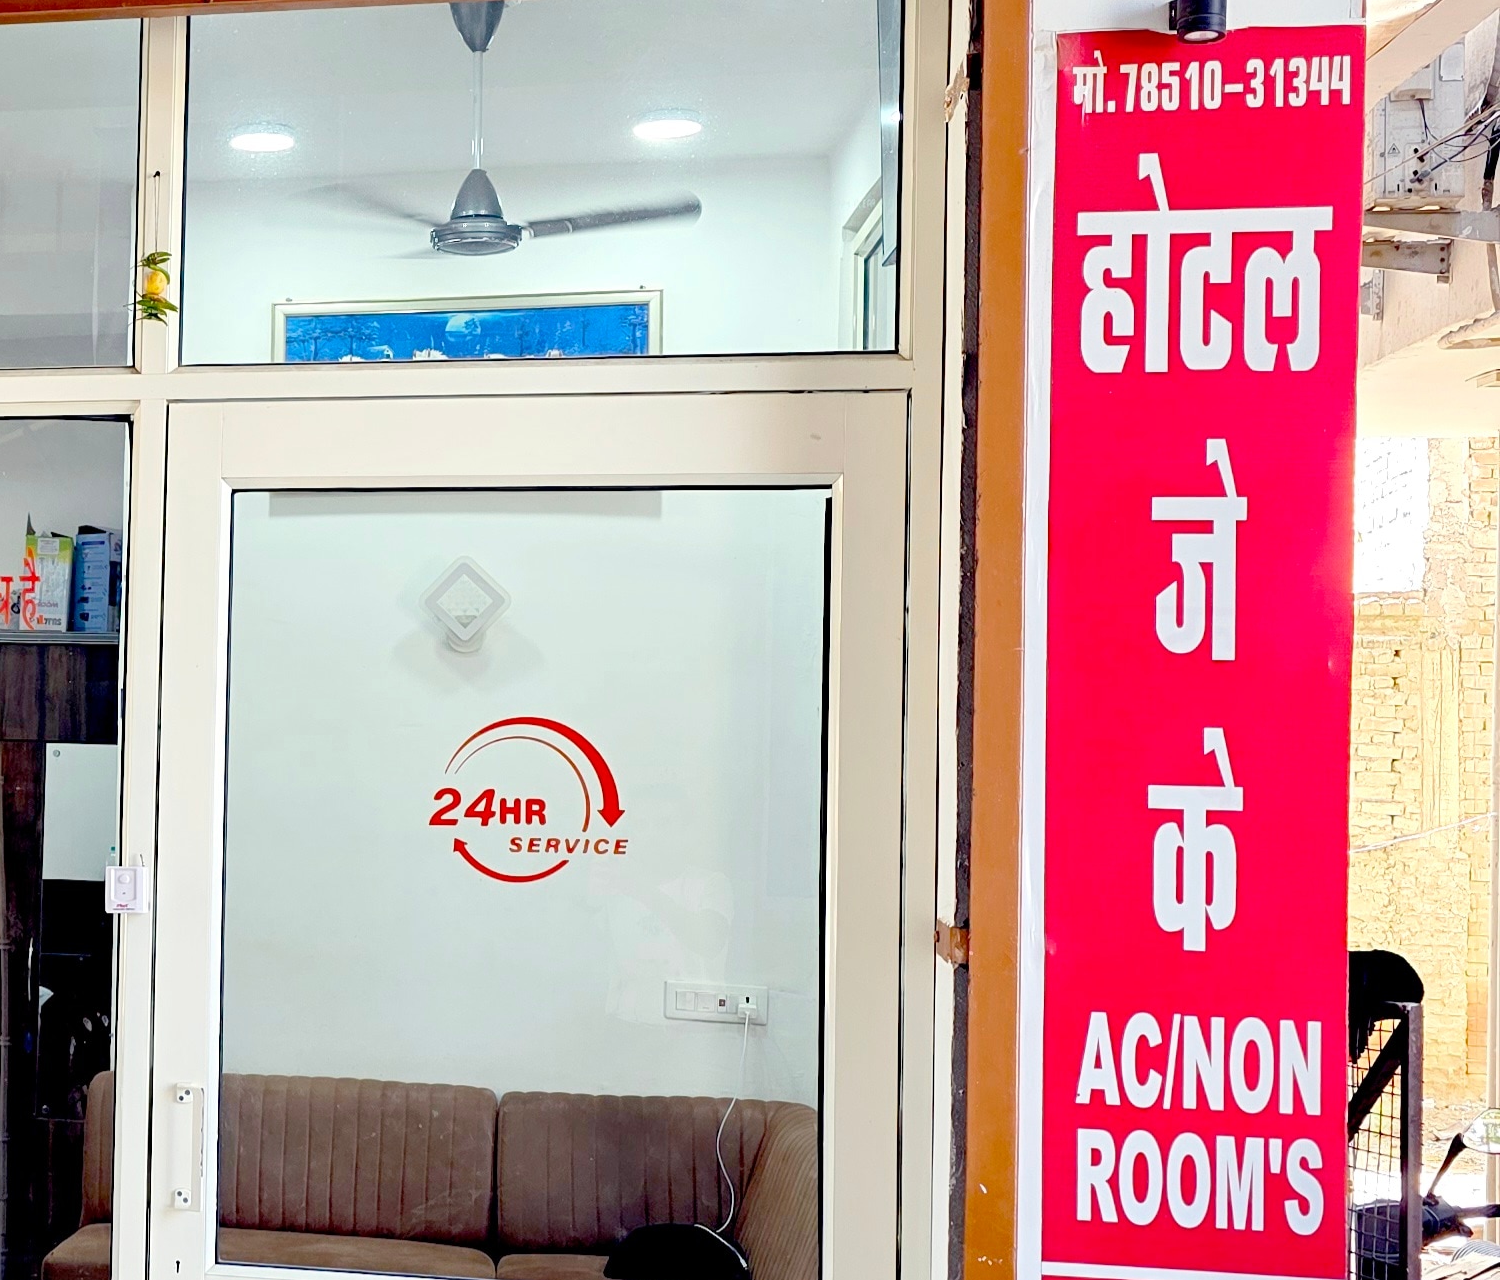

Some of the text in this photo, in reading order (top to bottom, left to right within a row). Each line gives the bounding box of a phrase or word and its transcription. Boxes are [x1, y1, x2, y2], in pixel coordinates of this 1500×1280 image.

[1077, 154, 1332, 373] होटल
[19, 547, 41, 630] है
[1152, 439, 1248, 661] जे
[428, 787, 546, 827] 24HR
[508, 837, 629, 855] SERVICE
[1148, 728, 1243, 951] के
[1076, 1011, 1322, 1117] AC/NON
[1076, 1128, 1325, 1236] ROOM'S
